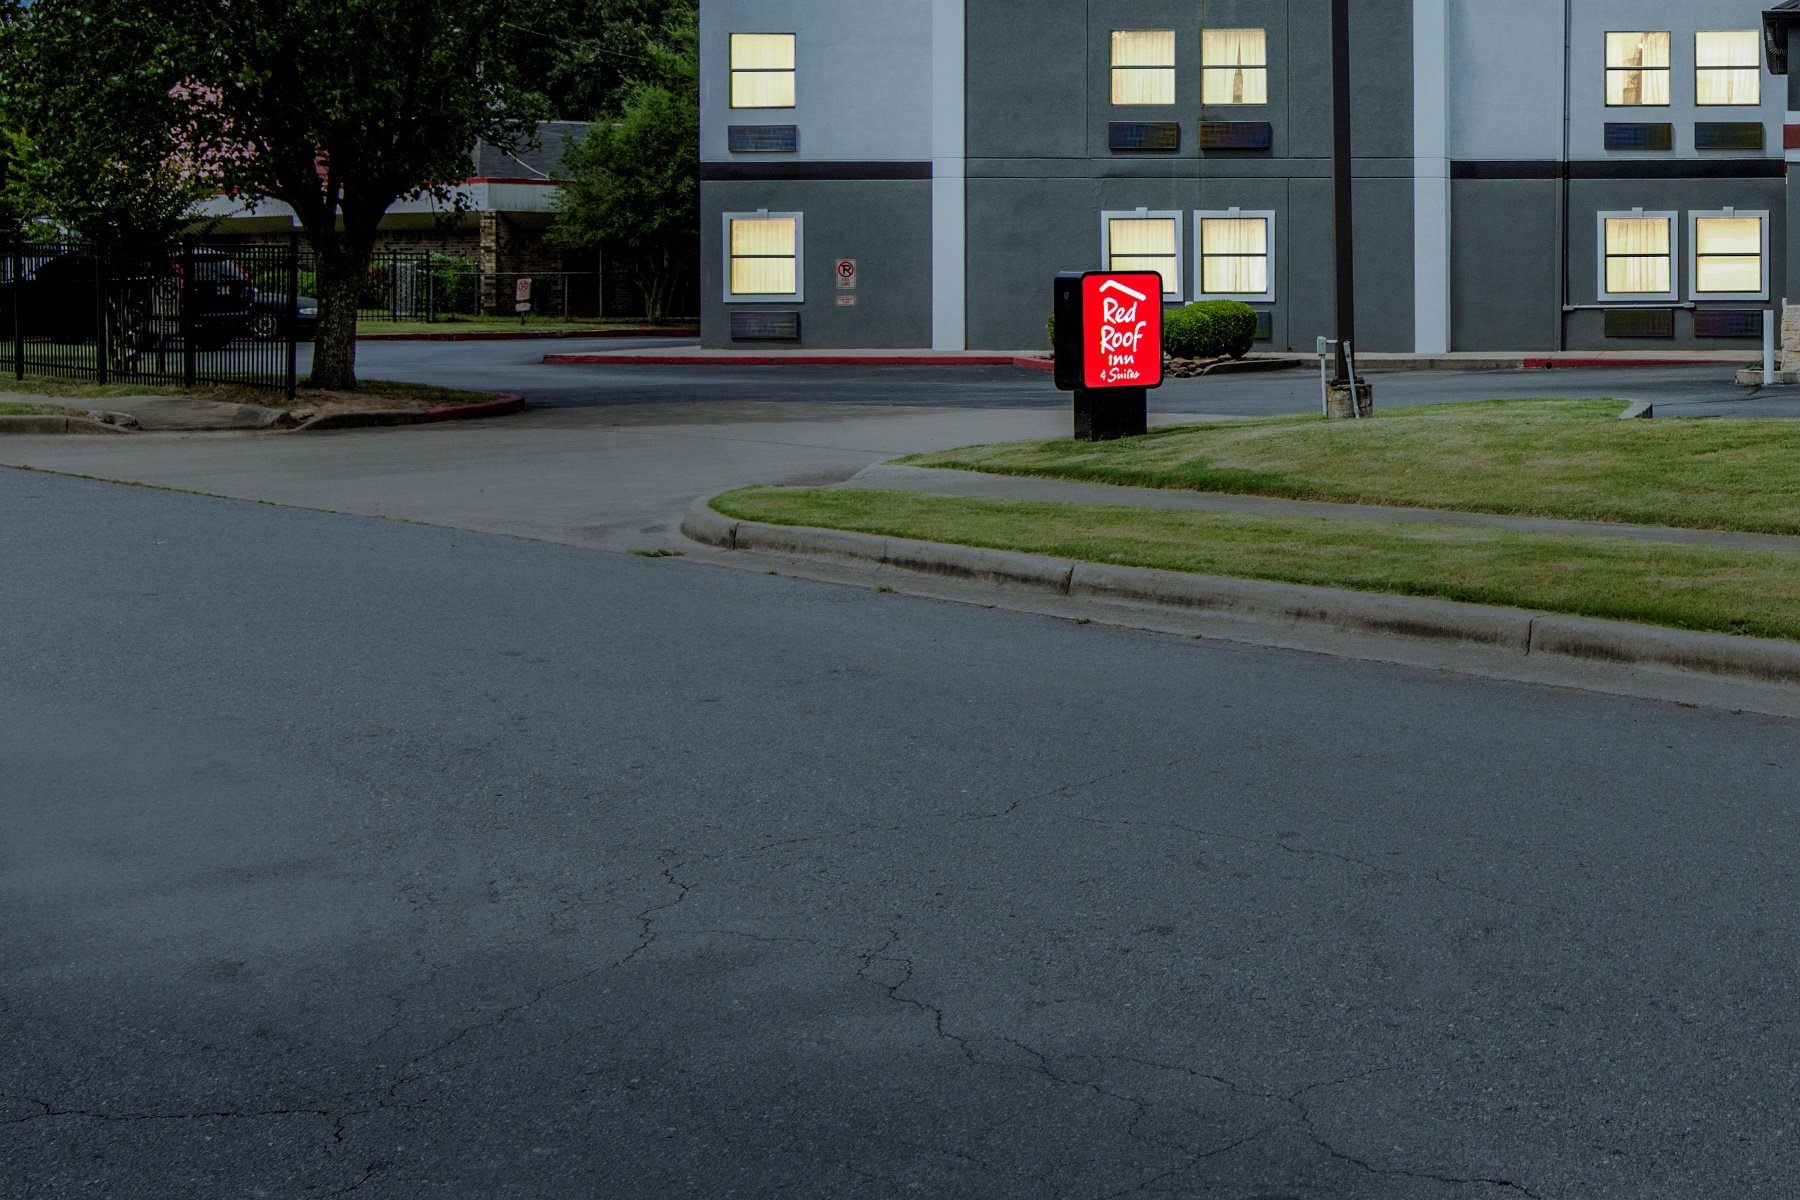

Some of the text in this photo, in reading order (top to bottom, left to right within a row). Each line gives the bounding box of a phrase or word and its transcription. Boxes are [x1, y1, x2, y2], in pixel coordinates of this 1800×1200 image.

[1103, 297, 1138, 325] Red
[1100, 320, 1147, 355] Roof
[1099, 366, 1141, 383] & Suites
